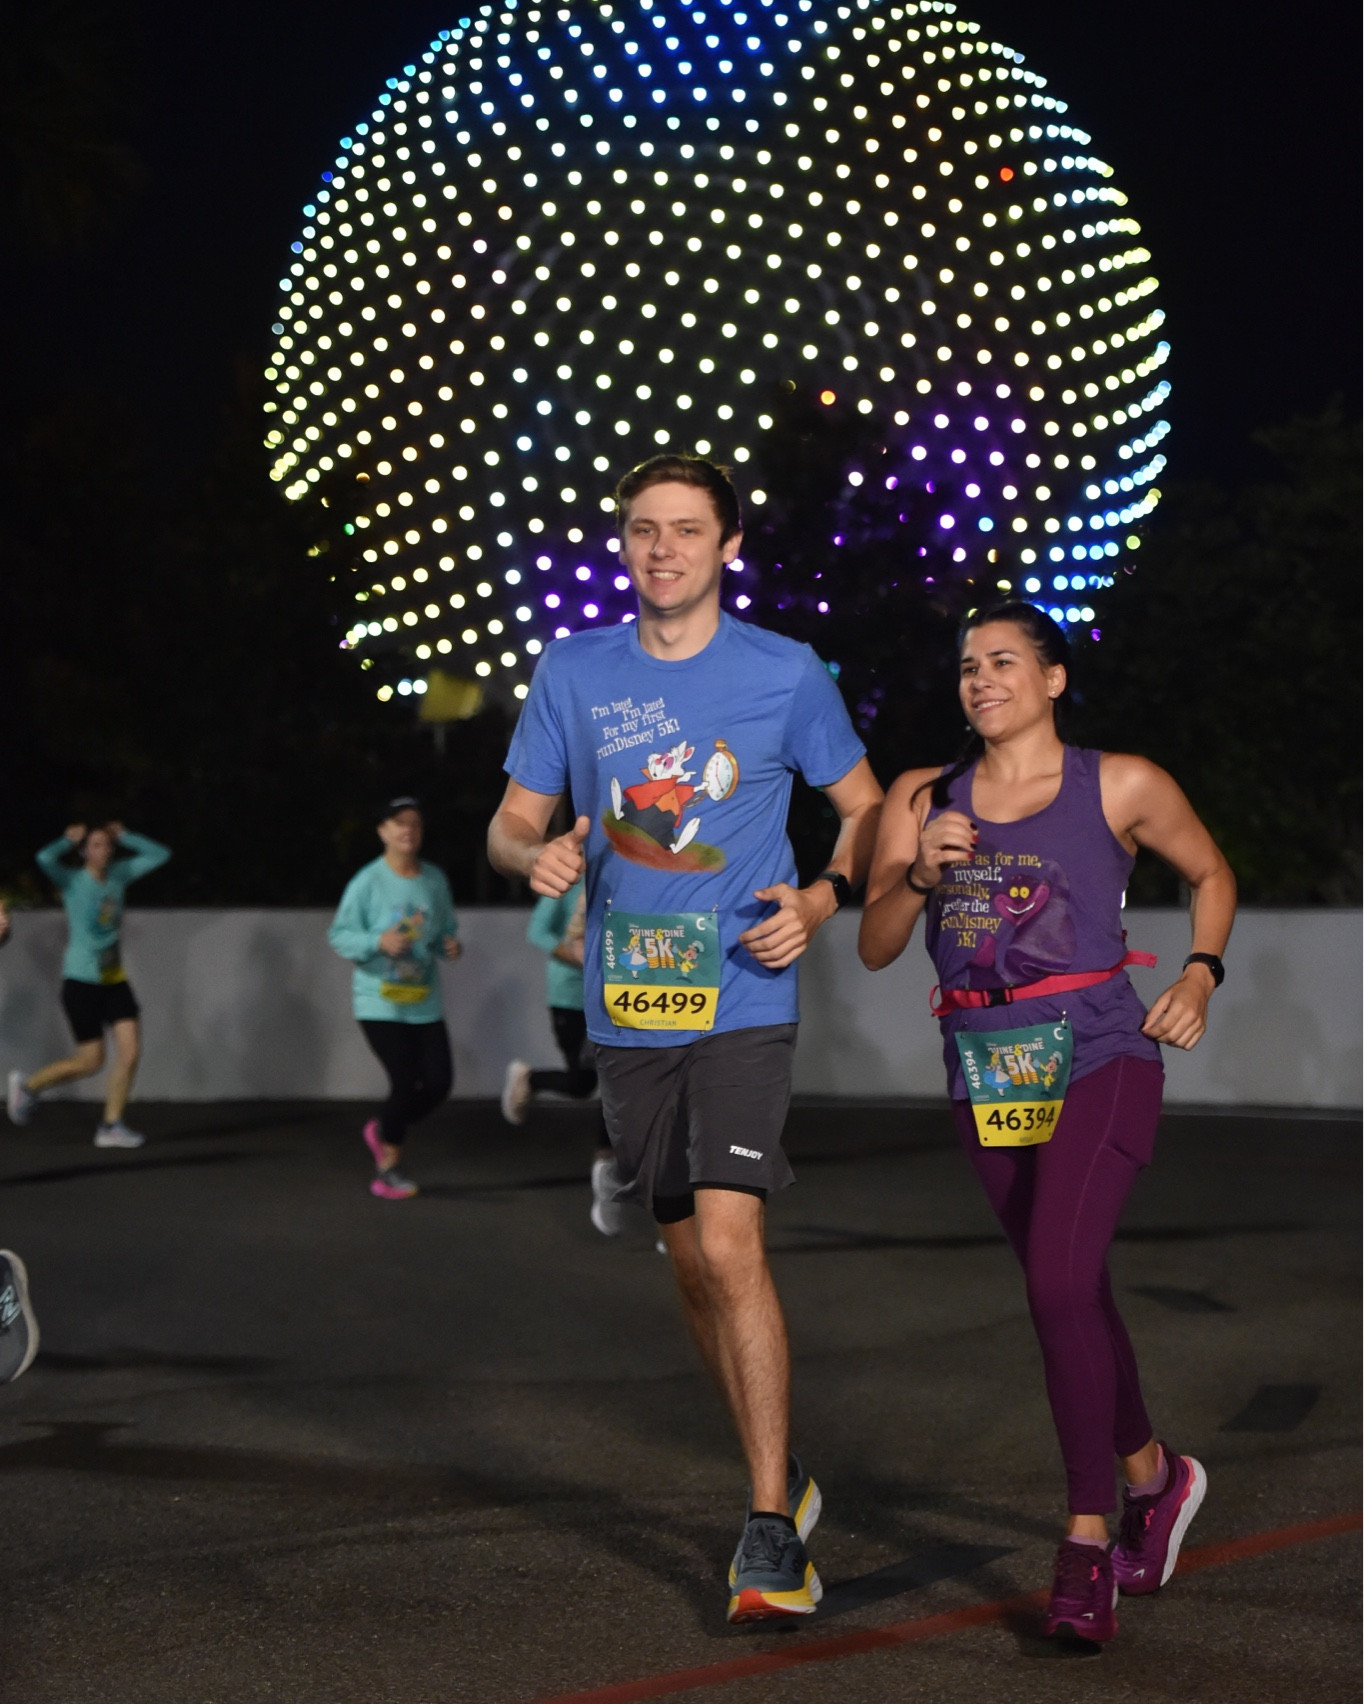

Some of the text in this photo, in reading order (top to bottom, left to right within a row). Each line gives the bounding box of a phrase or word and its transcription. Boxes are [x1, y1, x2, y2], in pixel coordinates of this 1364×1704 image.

[592, 697, 632, 720] I'm late!
[622, 698, 666, 721] I'm late!
[603, 710, 666, 740] For my first
[596, 718, 680, 760] runDisney 5K!
[975, 855, 990, 866] as
[995, 852, 1014, 866] for
[1018, 854, 1042, 868] me,
[954, 866, 1002, 883] myself,
[970, 899, 990, 912] the
[629, 929, 656, 938] WINE
[662, 929, 685, 938] DINE
[696, 917, 706, 930] C
[606, 930, 616, 970] 46499
[644, 938, 674, 964] 5K
[613, 991, 706, 1014] 46499
[1053, 1027, 1064, 1040] C
[1021, 1042, 1045, 1052] DINE
[964, 1050, 980, 1089] 46394
[1004, 1053, 1039, 1080] 5K
[986, 1106, 1055, 1130] 46394
